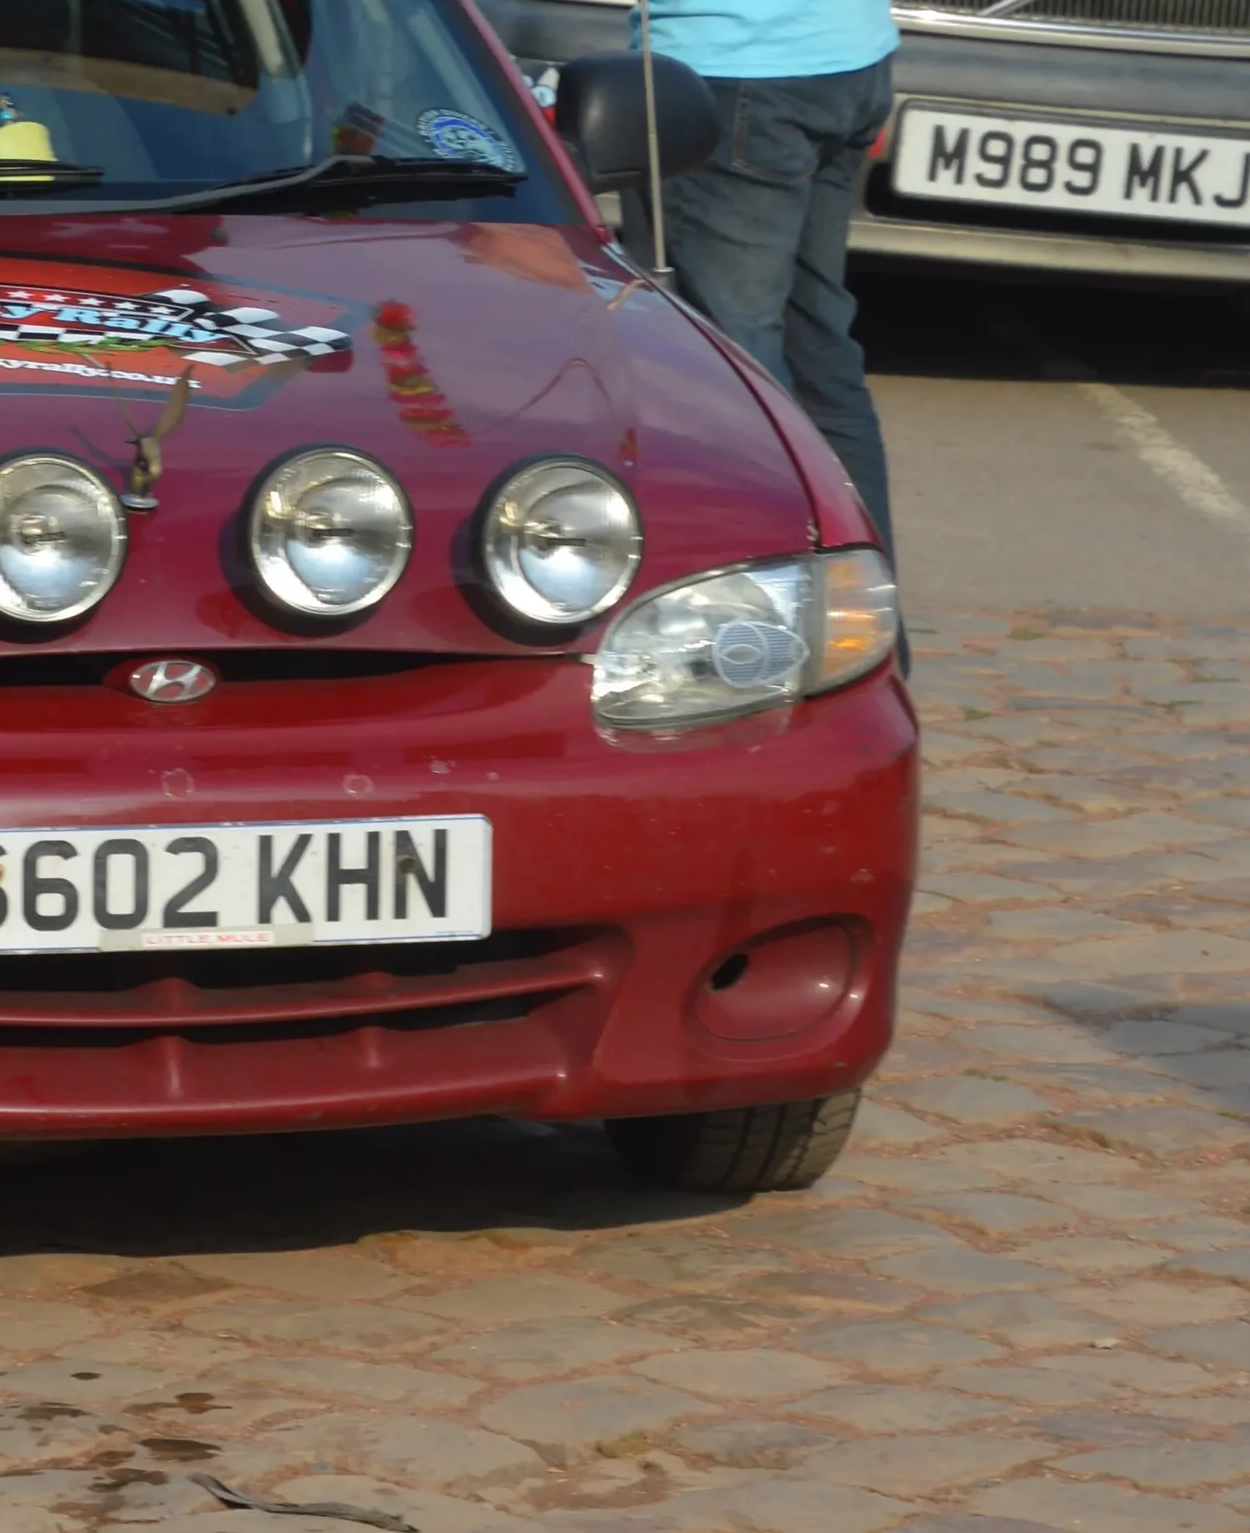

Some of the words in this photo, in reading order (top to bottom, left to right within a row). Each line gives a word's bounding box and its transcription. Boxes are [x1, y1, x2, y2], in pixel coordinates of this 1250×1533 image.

[926, 124, 1104, 196] M989
[1123, 142, 1250, 209] MKJ
[52, 306, 231, 343] Rally
[257, 828, 449, 925] KHN
